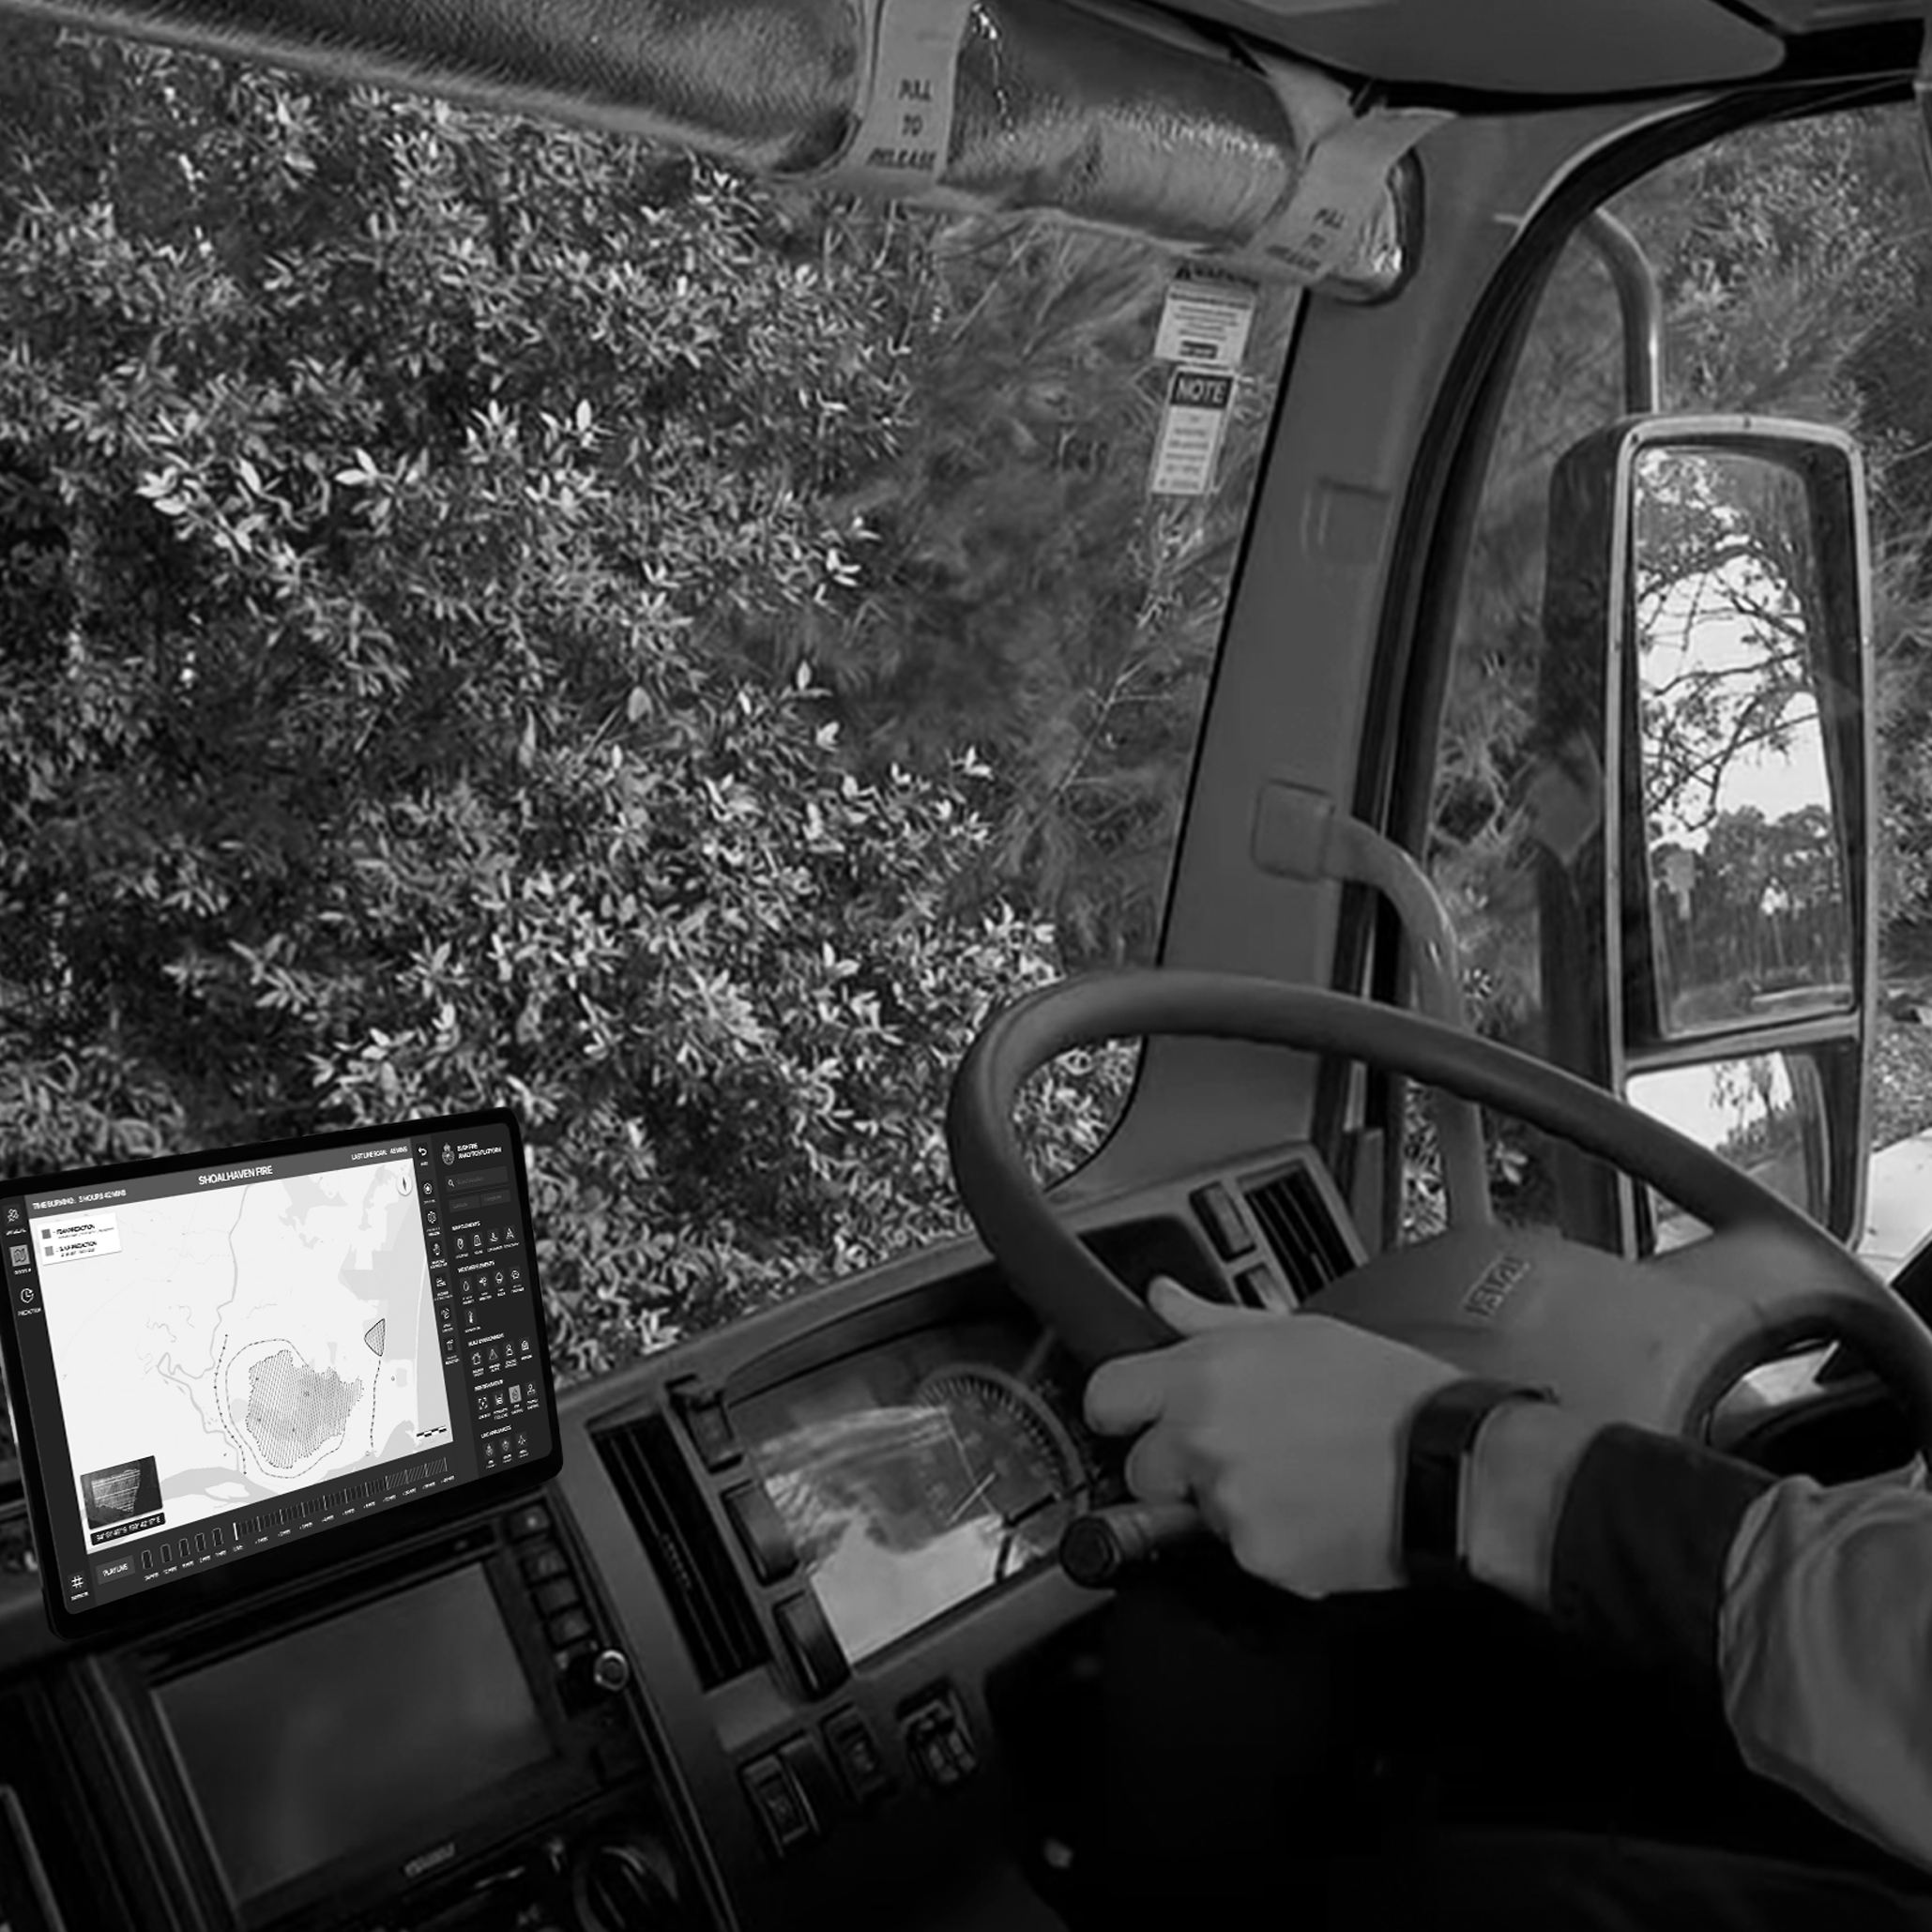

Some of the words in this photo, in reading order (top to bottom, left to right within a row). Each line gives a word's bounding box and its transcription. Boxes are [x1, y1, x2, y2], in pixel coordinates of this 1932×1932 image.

[902, 114, 924, 136] TO
[1176, 377, 1226, 403] NOTE
[198, 1167, 255, 1185] SHOALHAVEN
[255, 1164, 273, 1176] FIRE
